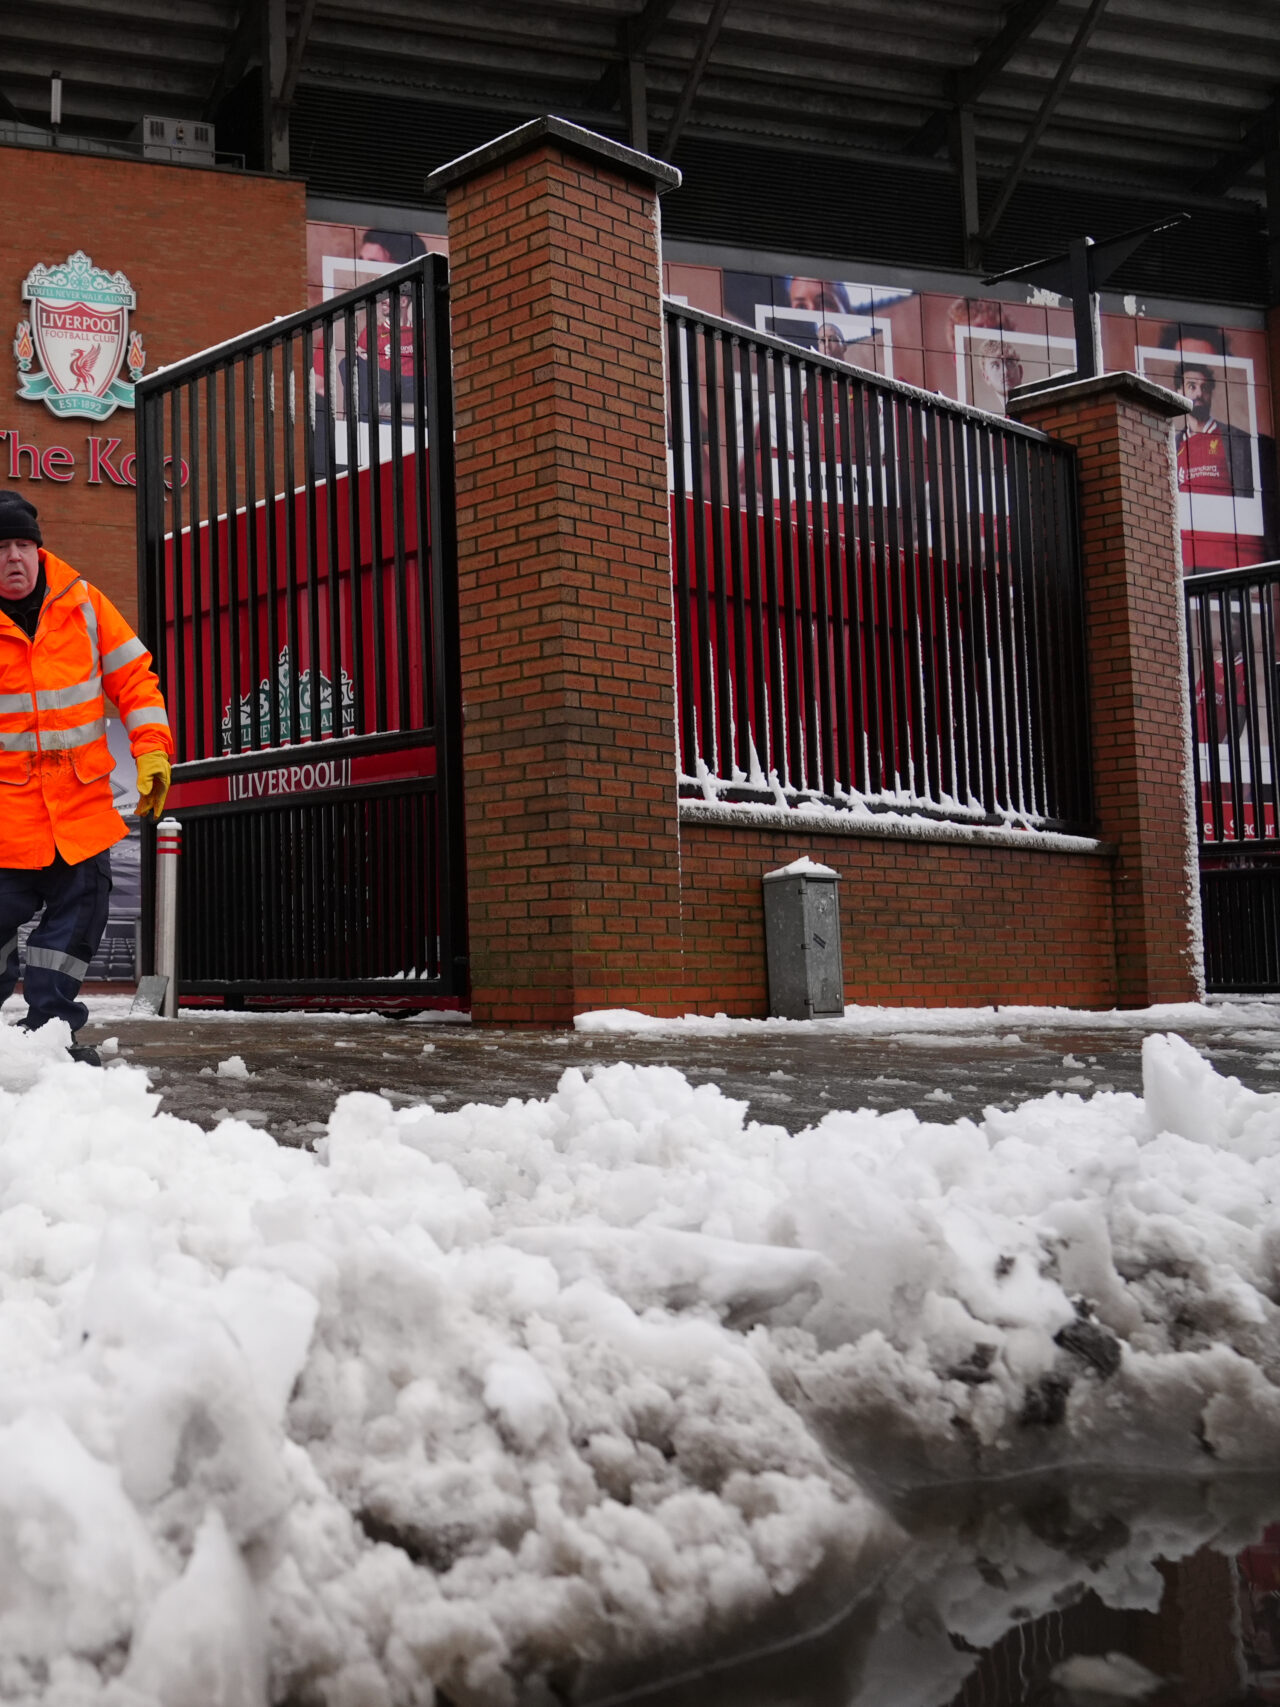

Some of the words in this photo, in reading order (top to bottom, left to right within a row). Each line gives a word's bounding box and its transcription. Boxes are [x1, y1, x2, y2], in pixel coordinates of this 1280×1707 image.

[56, 289, 79, 299] NEVER
[80, 291, 104, 301] WALK
[106, 293, 131, 305] ALONE
[41, 312, 119, 333] LIVERPOOL
[45, 330, 89, 341] FOOTBALL
[92, 334, 116, 343] CLUB
[239, 761, 340, 799] LIVERPOOL
